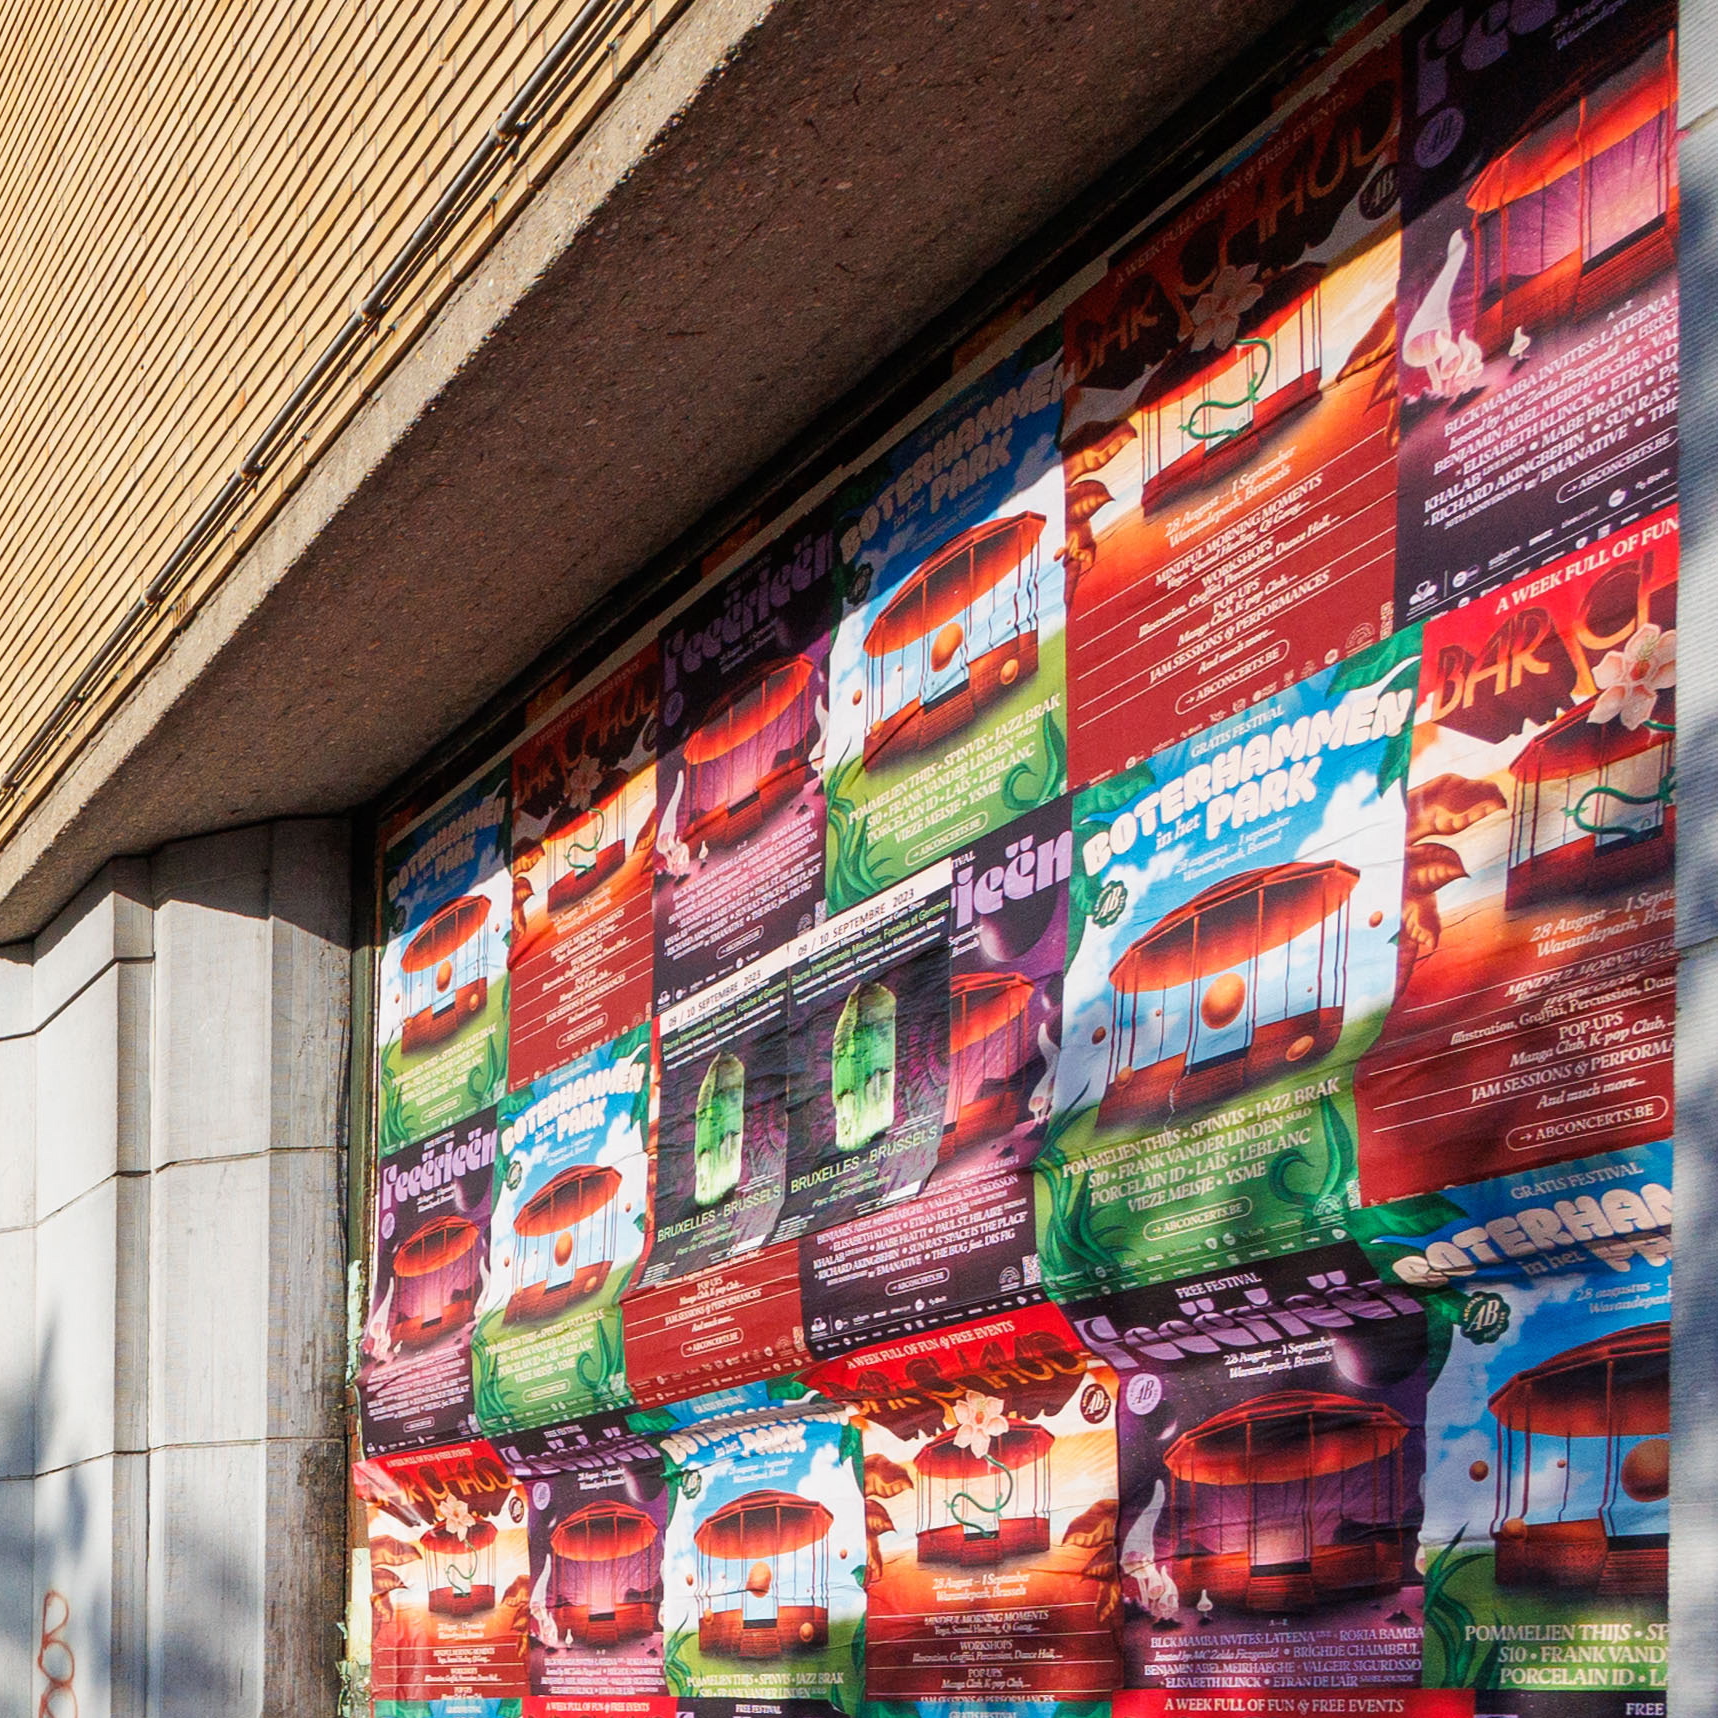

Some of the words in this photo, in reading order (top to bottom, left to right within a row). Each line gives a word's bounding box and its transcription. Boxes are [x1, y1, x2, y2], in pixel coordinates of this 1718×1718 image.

[1481, 371, 1537, 416] MAMBA
[1511, 570, 1562, 609] WEEK
[1564, 551, 1610, 583] FULL
[1612, 539, 1638, 560] OF
[1191, 729, 1231, 759] GRATIS
[1231, 704, 1285, 744] FESTIVAL
[1082, 688, 1413, 877] BOTERHAMMEN
[1156, 826, 1173, 851] in
[1175, 813, 1200, 842] het
[1206, 756, 1322, 840] PARK
[1530, 922, 1552, 942] 28
[1553, 906, 1606, 937] August
[1256, 1092, 1292, 1121] JAZZ
[1295, 1076, 1340, 1105] BRAK
[1471, 1081, 1500, 1103] JAM
[1502, 1062, 1571, 1094] SESSIONS
[557, 1101, 607, 1142] PARK
[1536, 1096, 1653, 1148] ABCONCERTS.BE
[790, 1154, 859, 1195] BRUXELLES
[869, 1124, 936, 1164] BRUSSELS
[1239, 1126, 1310, 1162] LEBLANC
[1511, 1174, 1565, 1200] GRATIS
[1569, 1161, 1644, 1191] FESTIVAL
[1176, 1282, 1205, 1300] FREE
[1207, 1272, 1262, 1294] FESTIVAL
[1465, 1625, 1577, 1641] POMMELIEN
[1579, 1624, 1632, 1643] THIJS
[1541, 1646, 1606, 1664] FRANK
[1500, 1668, 1611, 1686] PORCELAIN
[1612, 1668, 1634, 1686] ID
[1164, 1698, 1175, 1711] A
[1176, 1698, 1213, 1712] WEEK
[1214, 1698, 1247, 1712] FULL
[1247, 1699, 1265, 1712] OF
[1267, 1699, 1294, 1712] FUN
[1297, 1699, 1310, 1715] &
[1312, 1699, 1345, 1712] FREE
[1348, 1700, 1404, 1713] EVENTS
[1625, 1703, 1664, 1716] FREE
